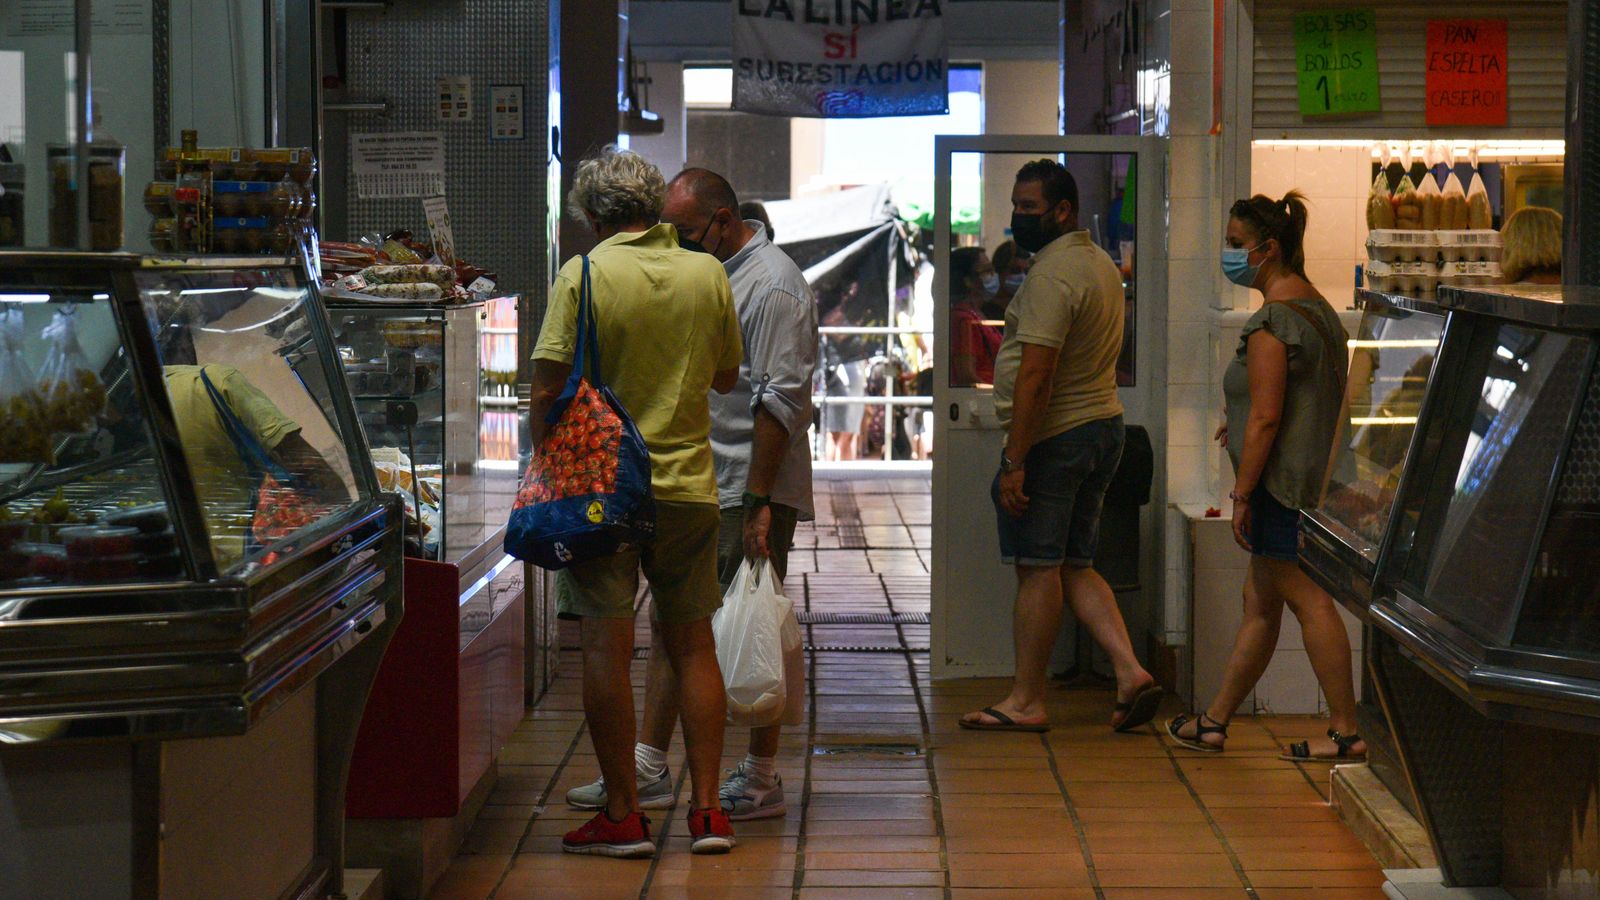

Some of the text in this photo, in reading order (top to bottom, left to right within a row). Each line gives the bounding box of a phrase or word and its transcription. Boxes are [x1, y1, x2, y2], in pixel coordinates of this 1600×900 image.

[738, 0, 794, 21] LA
[1303, 13, 1368, 33] BOLSAS
[1444, 24, 1478, 44] PAN
[824, 25, 859, 59] SÍ
[738, 55, 943, 85] SUBESTACIÓN
[1305, 51, 1363, 72] BOLLOS
[1429, 51, 1501, 74] ESPELTA
[1316, 75, 1331, 111] 1
